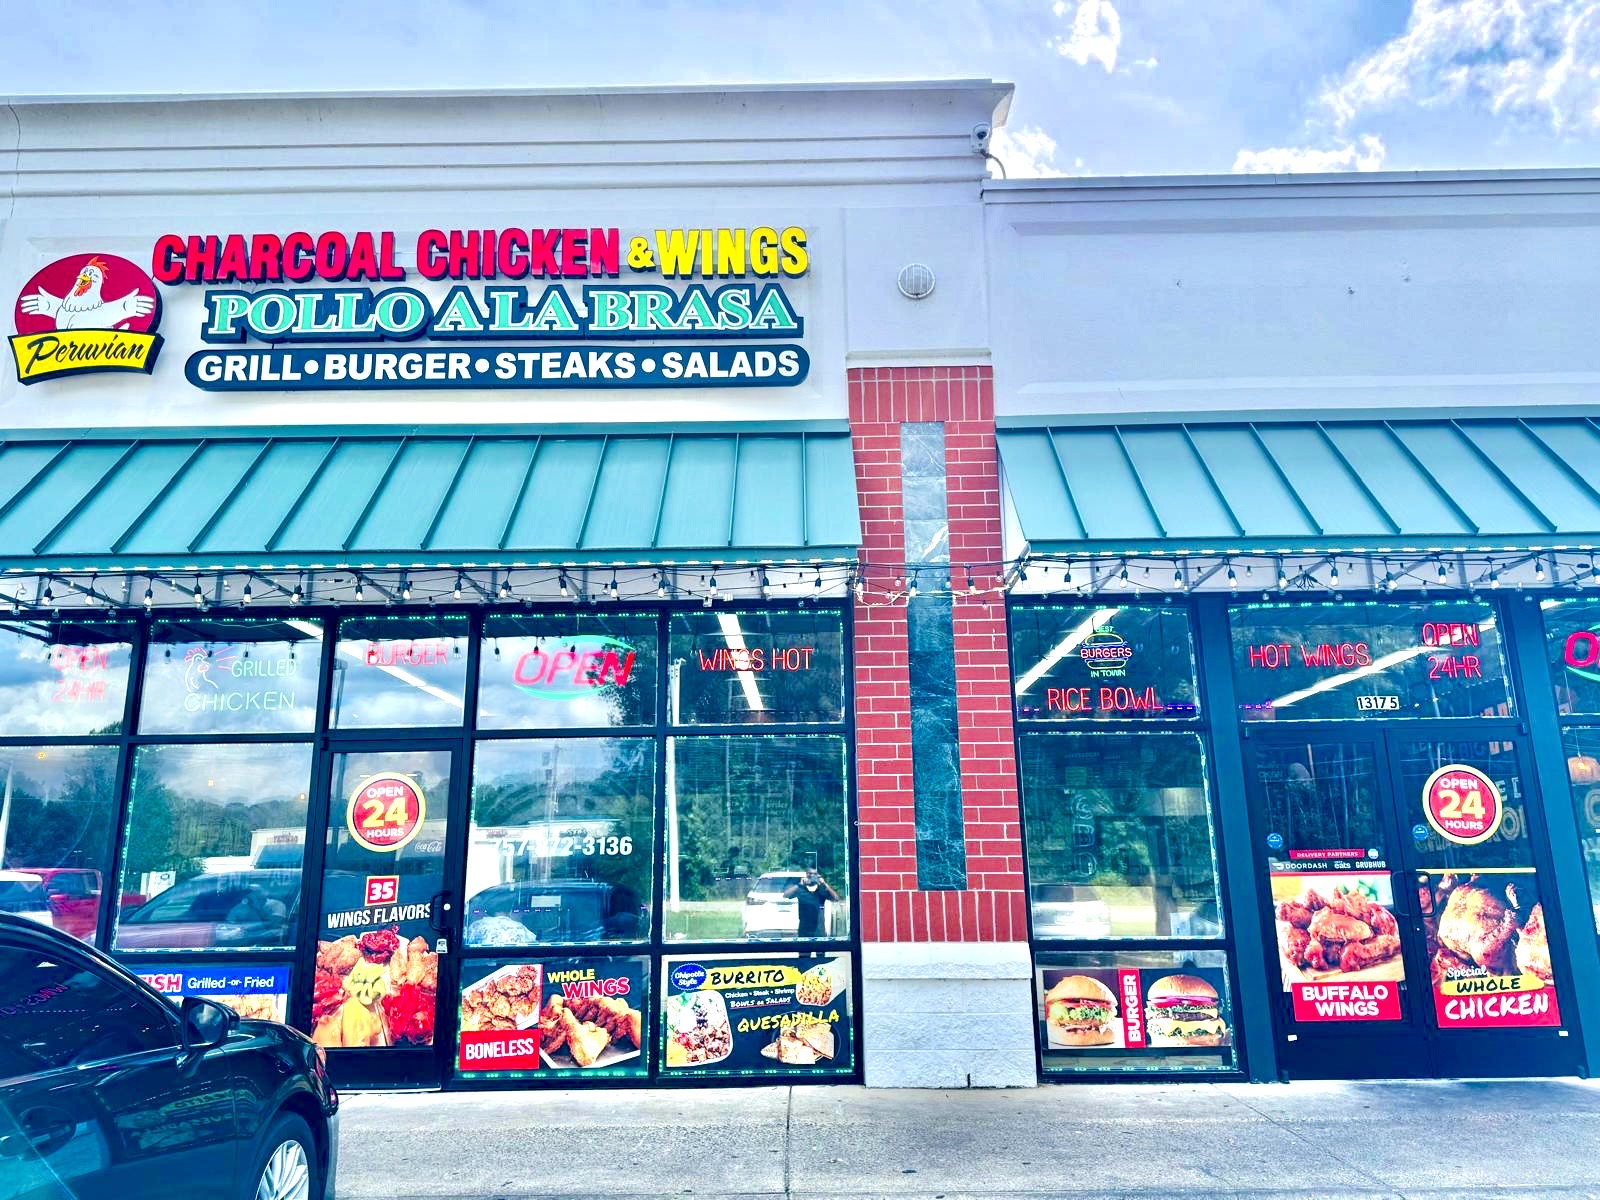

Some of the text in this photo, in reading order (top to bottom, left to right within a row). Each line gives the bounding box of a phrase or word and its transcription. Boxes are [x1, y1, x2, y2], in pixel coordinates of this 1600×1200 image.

[152, 226, 809, 283] CHARCOAL CHICKEN & WINGS
[207, 287, 799, 335] POLLO A LA BRASA
[25, 335, 146, 375] Peruvian
[198, 349, 800, 381] GRILL BURGER STEAKS SALADS
[1422, 622, 1479, 647] OPEN
[51, 645, 110, 672] OPEN
[365, 642, 449, 667] BURGER
[698, 647, 814, 672] WINGS HOT
[1080, 647, 1133, 659] BURGERS
[1250, 642, 1371, 669] HOT WINGS
[231, 659, 297, 678] GRILLED
[513, 649, 637, 688] OPEN
[1090, 669, 1126, 678] IN TOWN
[1427, 655, 1482, 680] 24HR
[184, 690, 296, 712] CHICKEN
[1047, 686, 1164, 712] RICE BOWL
[1358, 696, 1398, 710] 13175
[366, 785, 404, 798] OPEN
[1439, 778, 1478, 790] OPEN
[362, 798, 409, 828] 24
[1437, 789, 1486, 819] 24
[366, 827, 405, 839] HOURS
[1444, 820, 1484, 830] HOURS
[1355, 861, 1387, 869] GRUBHUB
[369, 881, 394, 901] 35
[327, 902, 431, 929] WINGS FLAVORS
[187, 976, 227, 989] Grilled
[244, 976, 275, 988] Fried
[547, 968, 596, 984] WHOLE
[674, 970, 705, 980] Chipotle
[710, 969, 785, 986] BURRITO
[1446, 965, 1488, 979] Special
[561, 976, 631, 1000] WINGS
[724, 991, 749, 999] Chicken
[774, 987, 796, 996] Shrimp
[1302, 984, 1388, 1001] BUFFALO
[1456, 977, 1522, 994] WHOLE
[1123, 973, 1142, 1042] BURGER
[1315, 1000, 1380, 1017] WINGS
[1444, 993, 1549, 1021] CHICKEN
[736, 1008, 840, 1033] QUESADILLA
[465, 1037, 535, 1061] BONELESS
